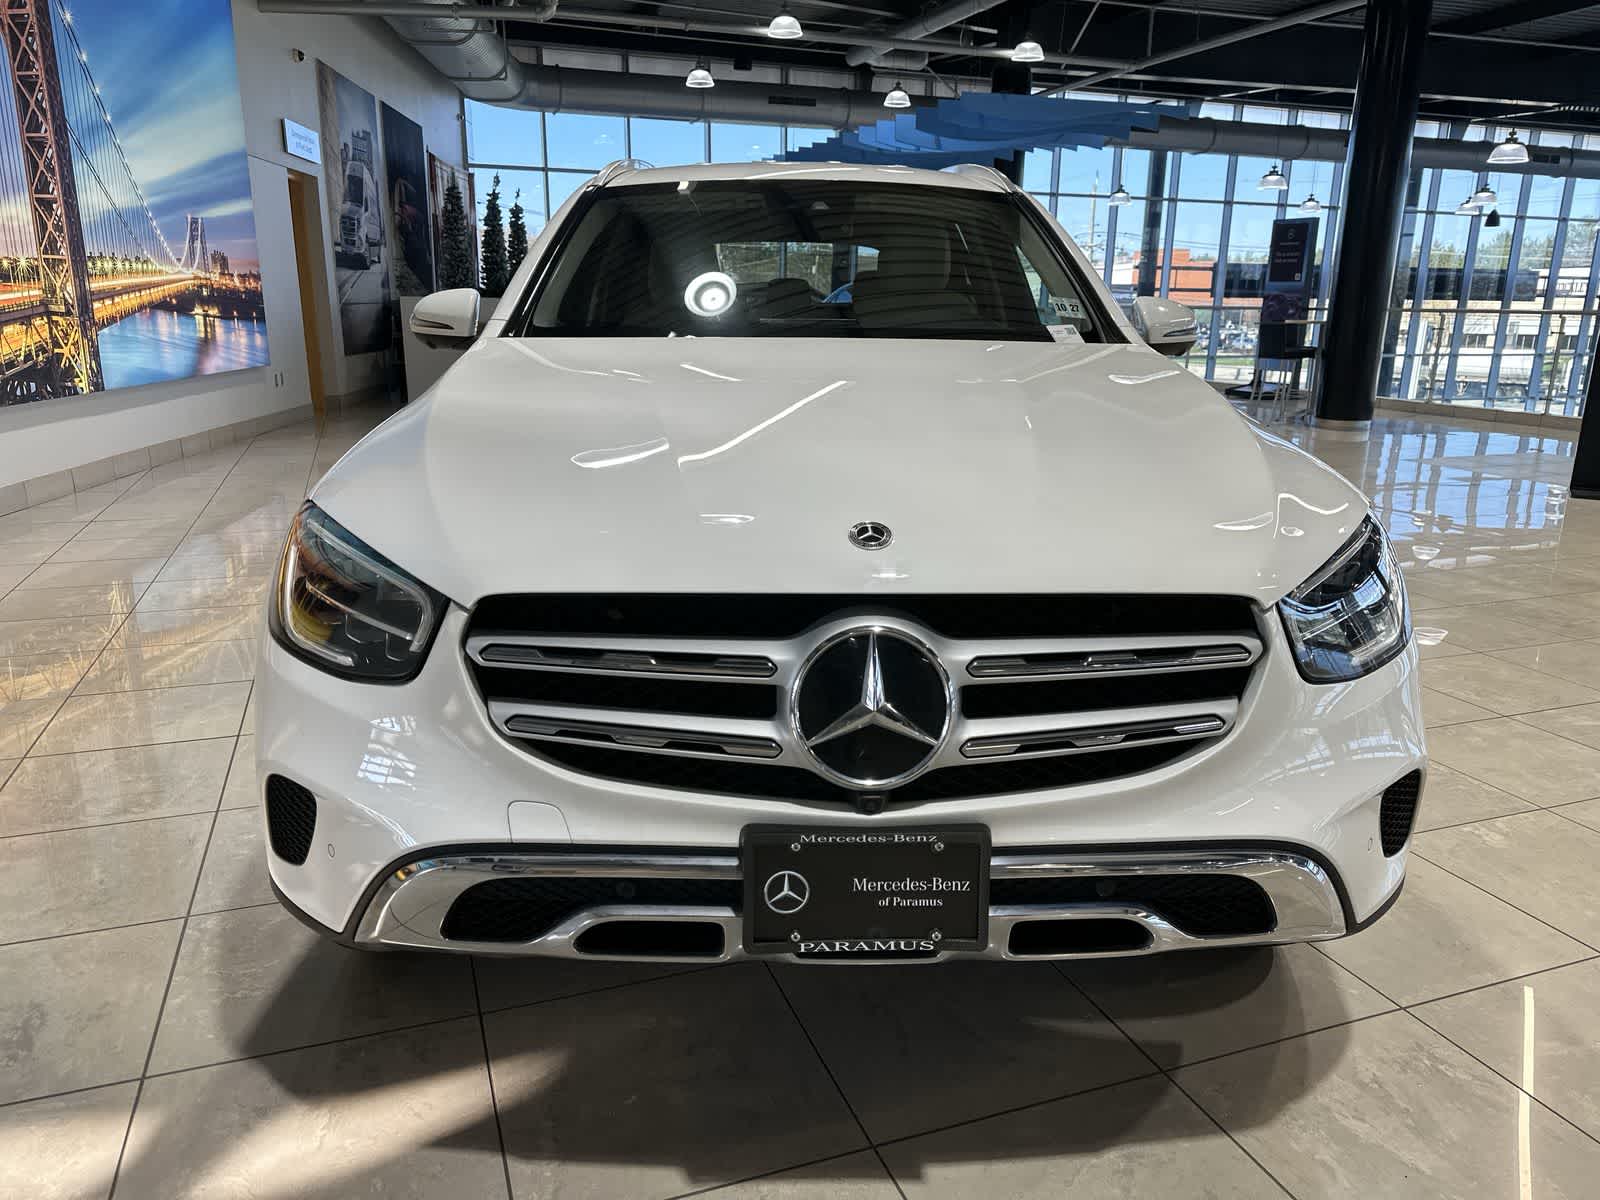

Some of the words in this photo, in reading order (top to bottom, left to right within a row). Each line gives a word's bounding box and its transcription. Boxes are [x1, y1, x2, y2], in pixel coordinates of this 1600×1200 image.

[1055, 303, 1067, 312] 10
[1069, 303, 1079, 312] 27
[800, 833, 938, 844] Mercedes-Benz
[853, 877, 971, 893] Mercedes-Benz
[878, 896, 890, 907] of
[892, 896, 943, 908] Paramus
[799, 939, 935, 953] PARAMUS
